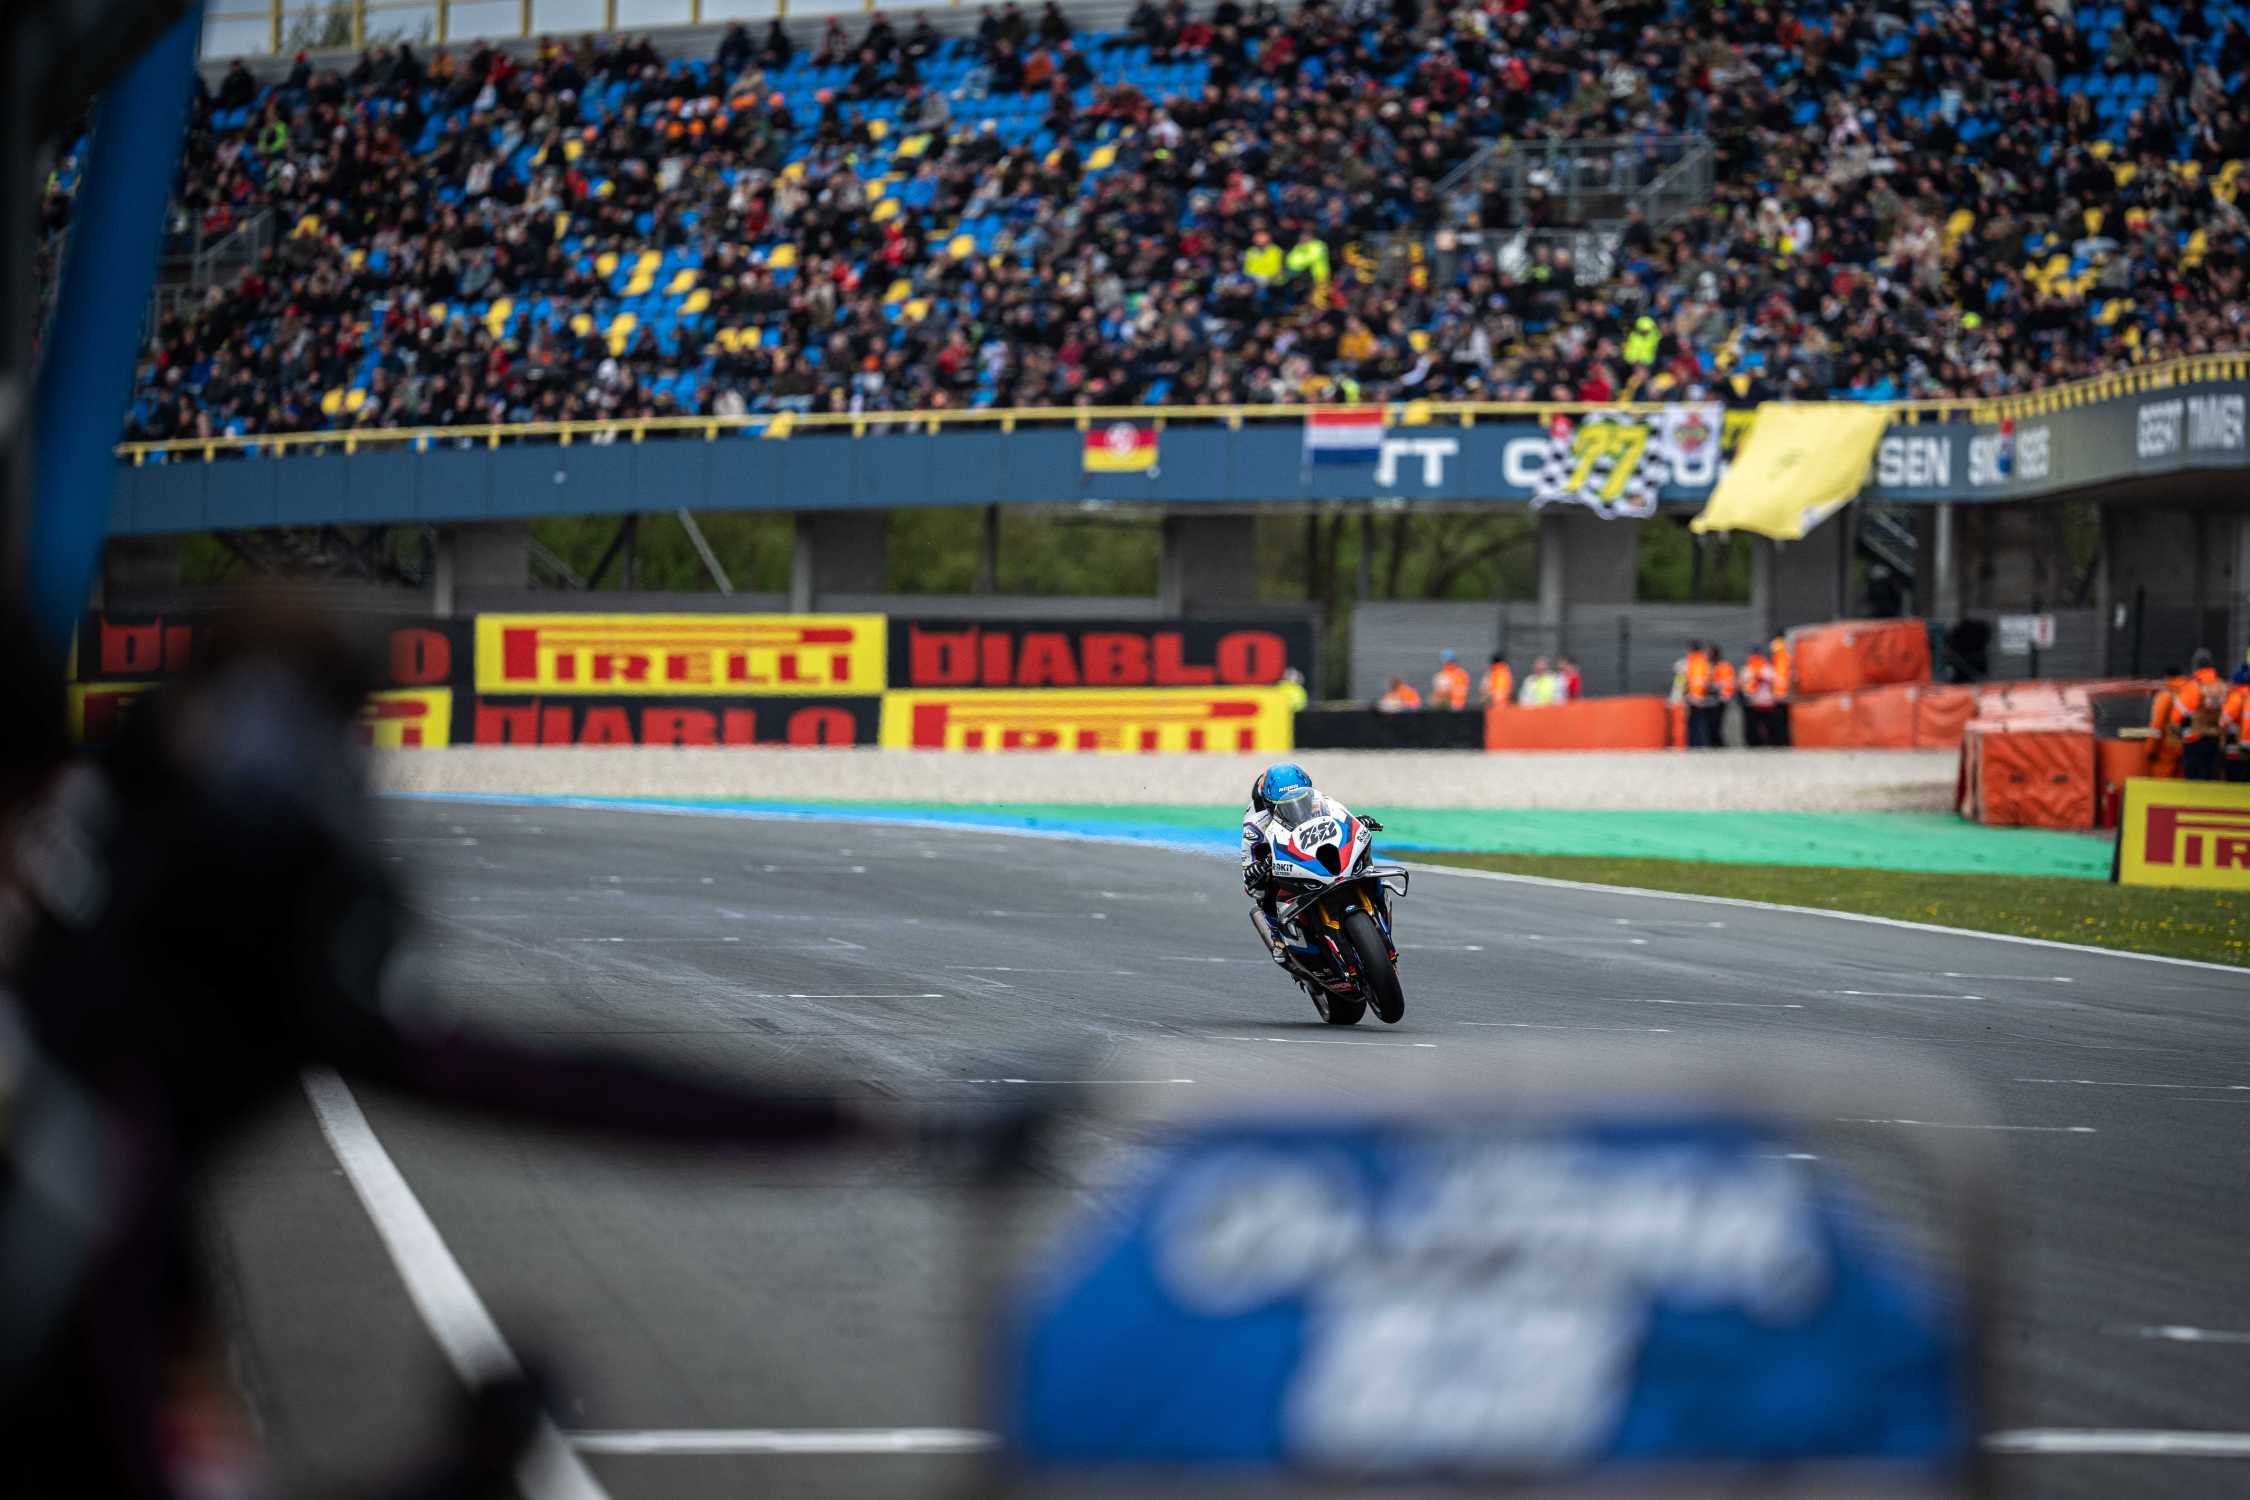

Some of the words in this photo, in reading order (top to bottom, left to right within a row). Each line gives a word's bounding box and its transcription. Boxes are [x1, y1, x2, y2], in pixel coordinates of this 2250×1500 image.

[1566, 422, 1648, 502] 77
[1877, 437, 1951, 488] SEN
[101, 614, 452, 685] DIO
[503, 624, 854, 682] PIRELLI
[911, 619, 1286, 686] DIABLO
[473, 697, 856, 746] DIABLO
